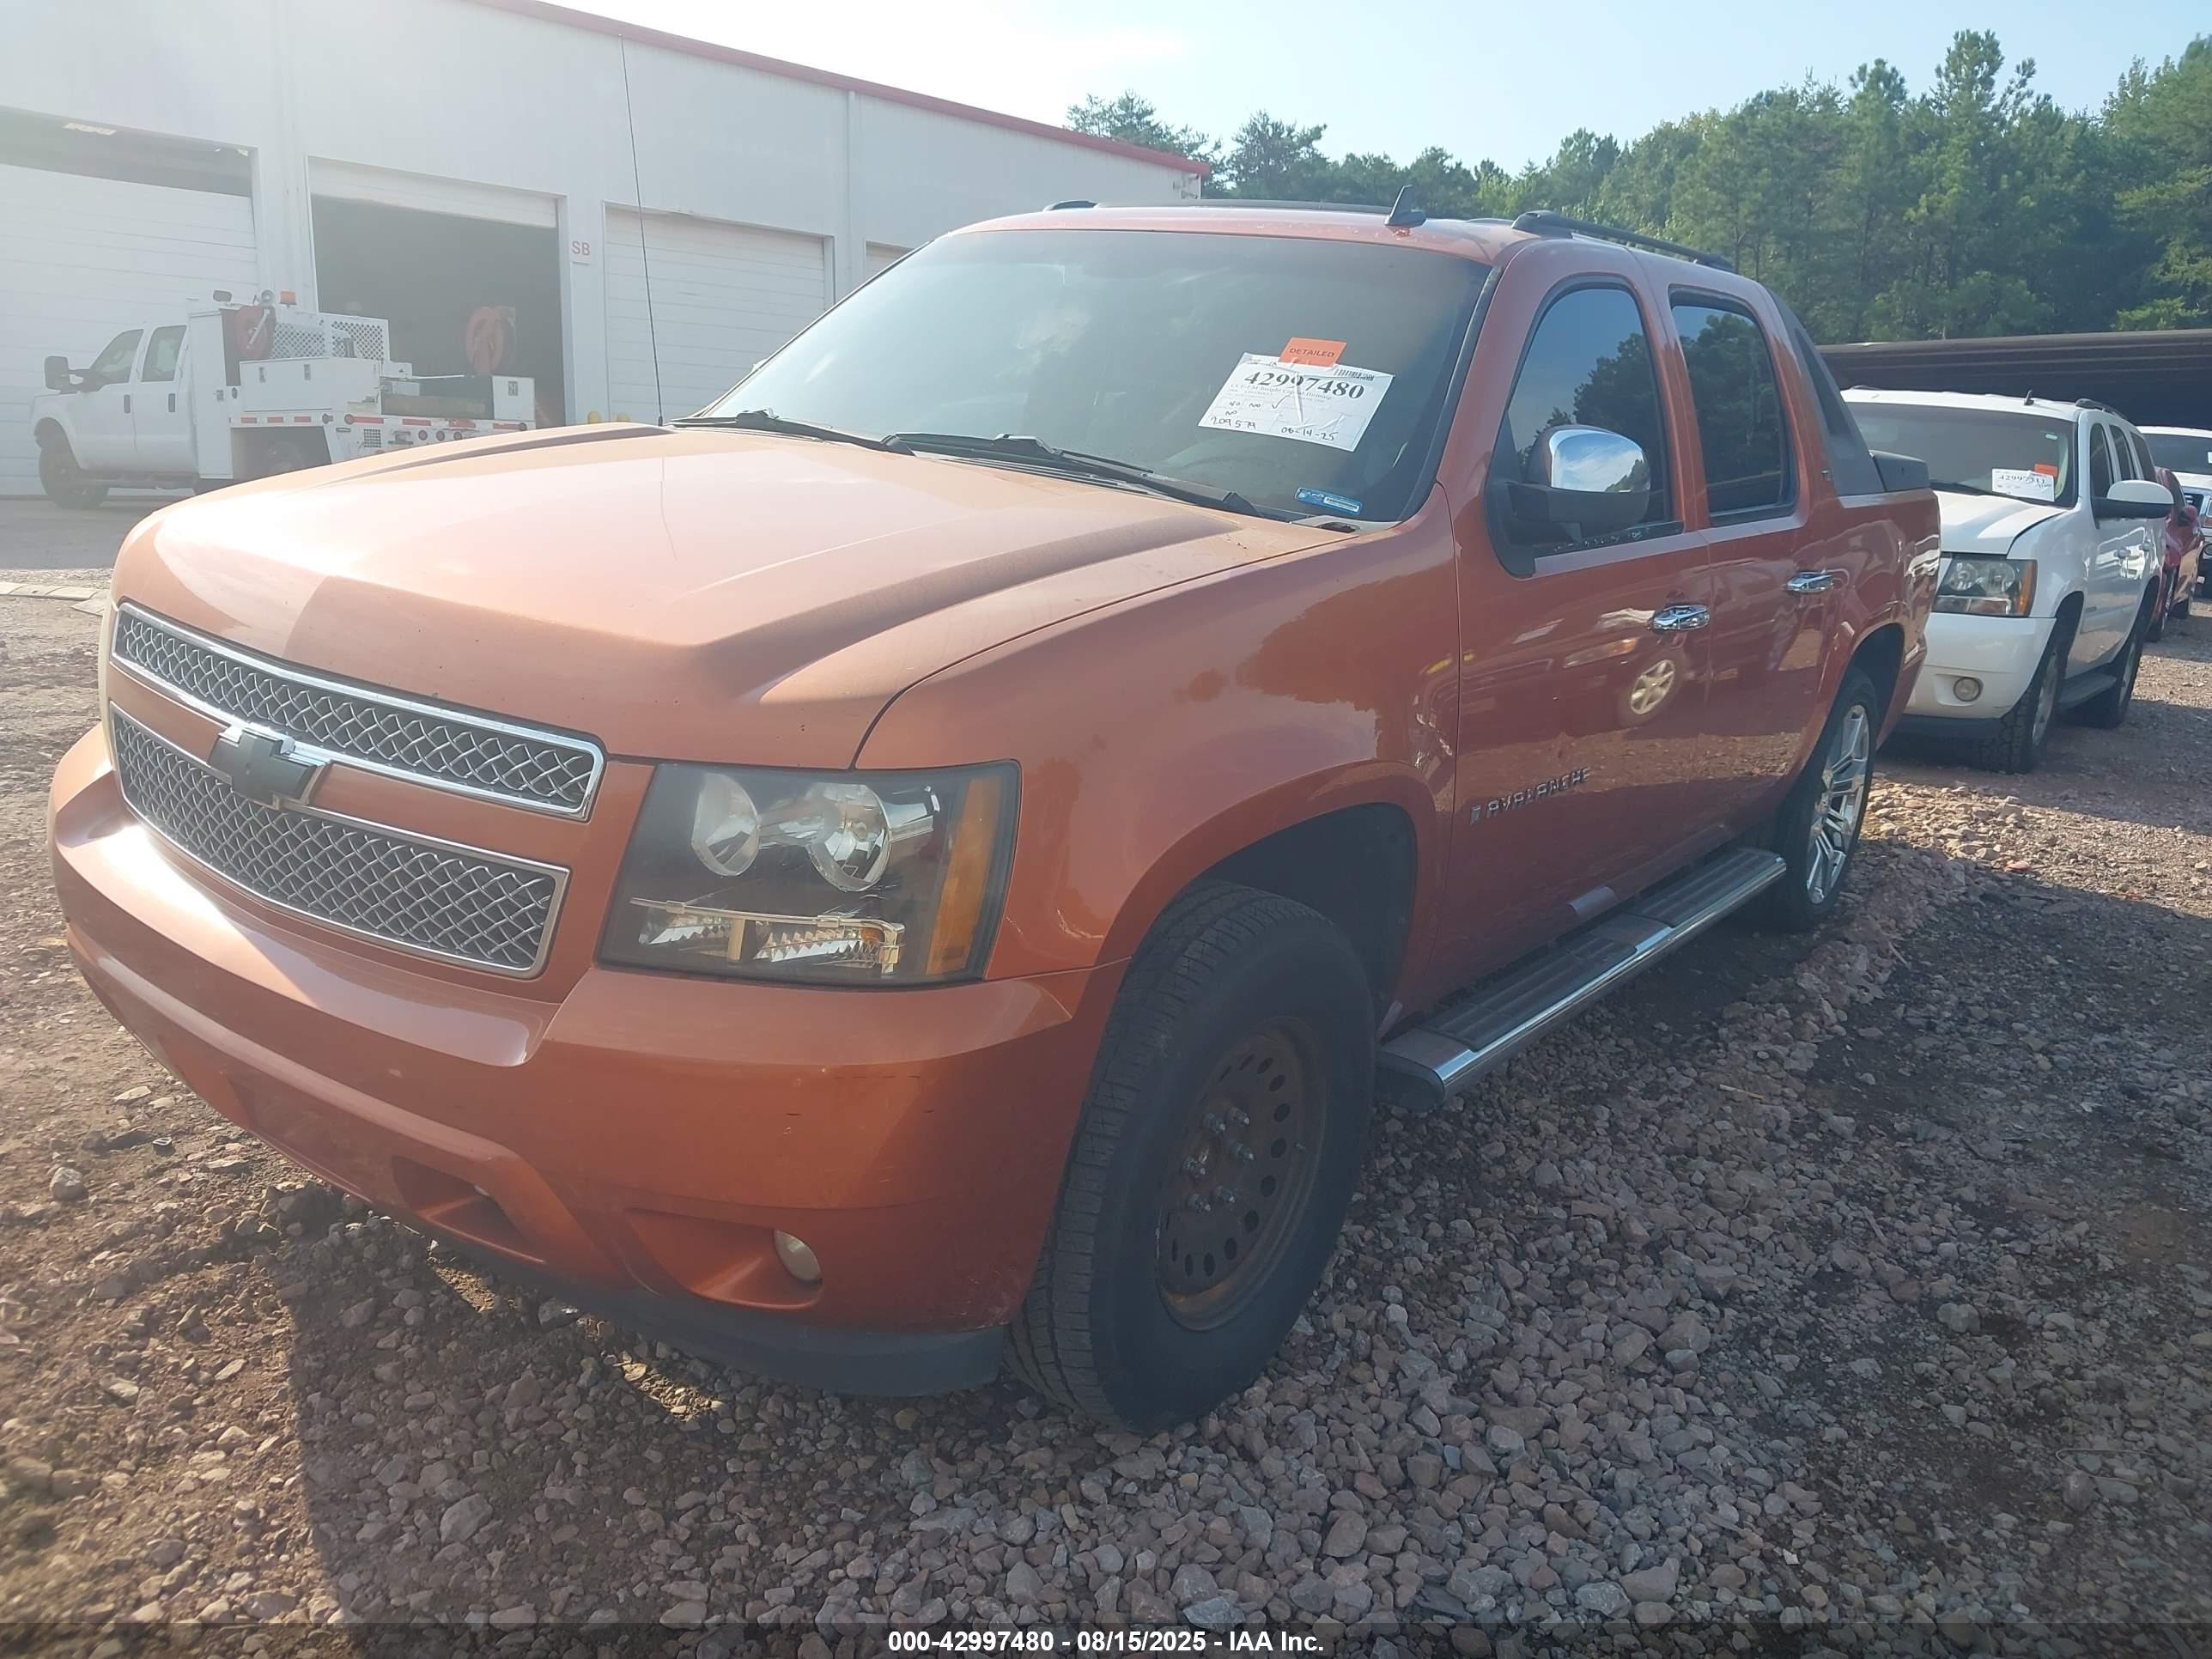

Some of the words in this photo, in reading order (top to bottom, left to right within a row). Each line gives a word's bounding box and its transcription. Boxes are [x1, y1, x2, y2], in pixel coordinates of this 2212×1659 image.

[1289, 348, 1335, 358] DETAILED
[1243, 371, 1365, 400] 42997480
[1486, 766, 1592, 818] AVALANCHE
